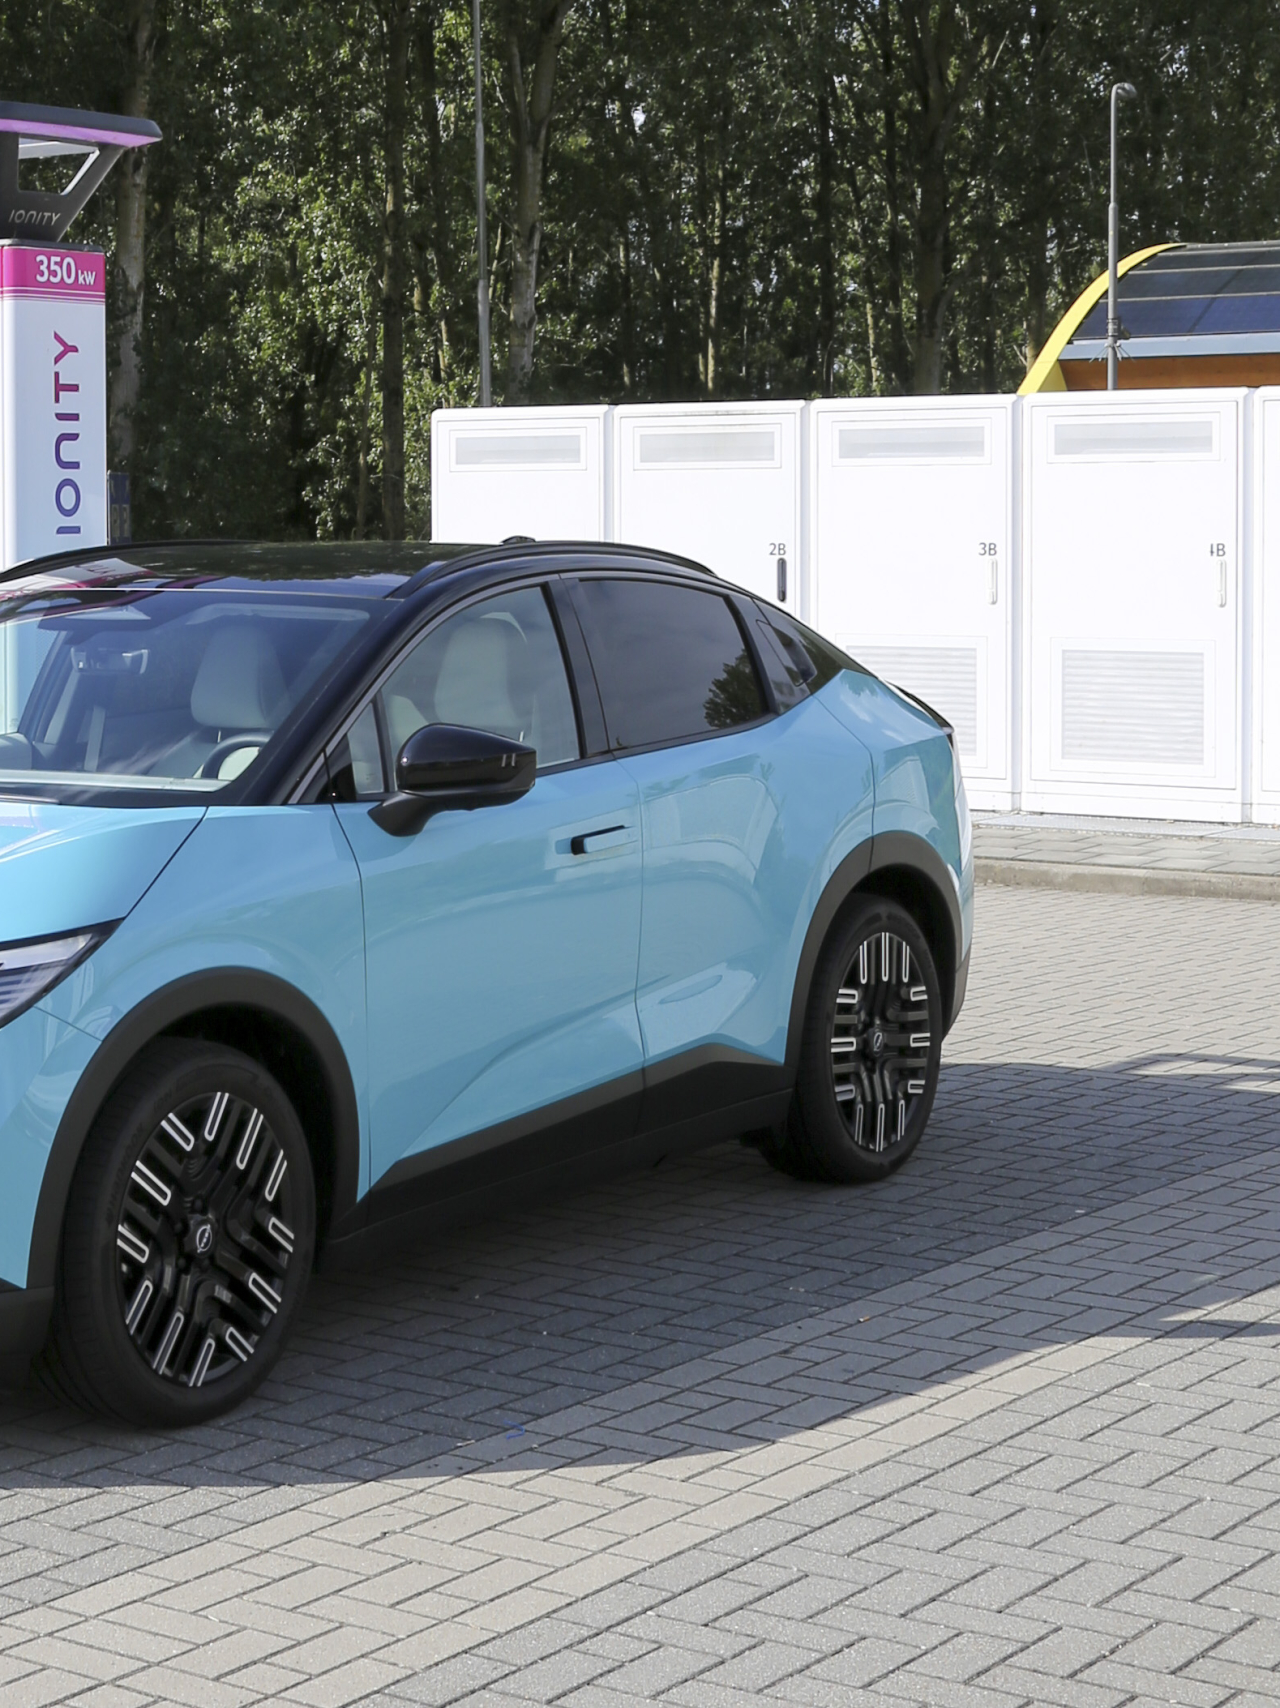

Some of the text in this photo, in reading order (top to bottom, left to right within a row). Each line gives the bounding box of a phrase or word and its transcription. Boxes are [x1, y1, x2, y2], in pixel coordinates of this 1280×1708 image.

[9, 209, 61, 227] IONITY
[35, 255, 96, 286] 350 kW
[53, 330, 82, 535] IONITY
[769, 542, 787, 556] 2B
[978, 542, 997, 556] 3B
